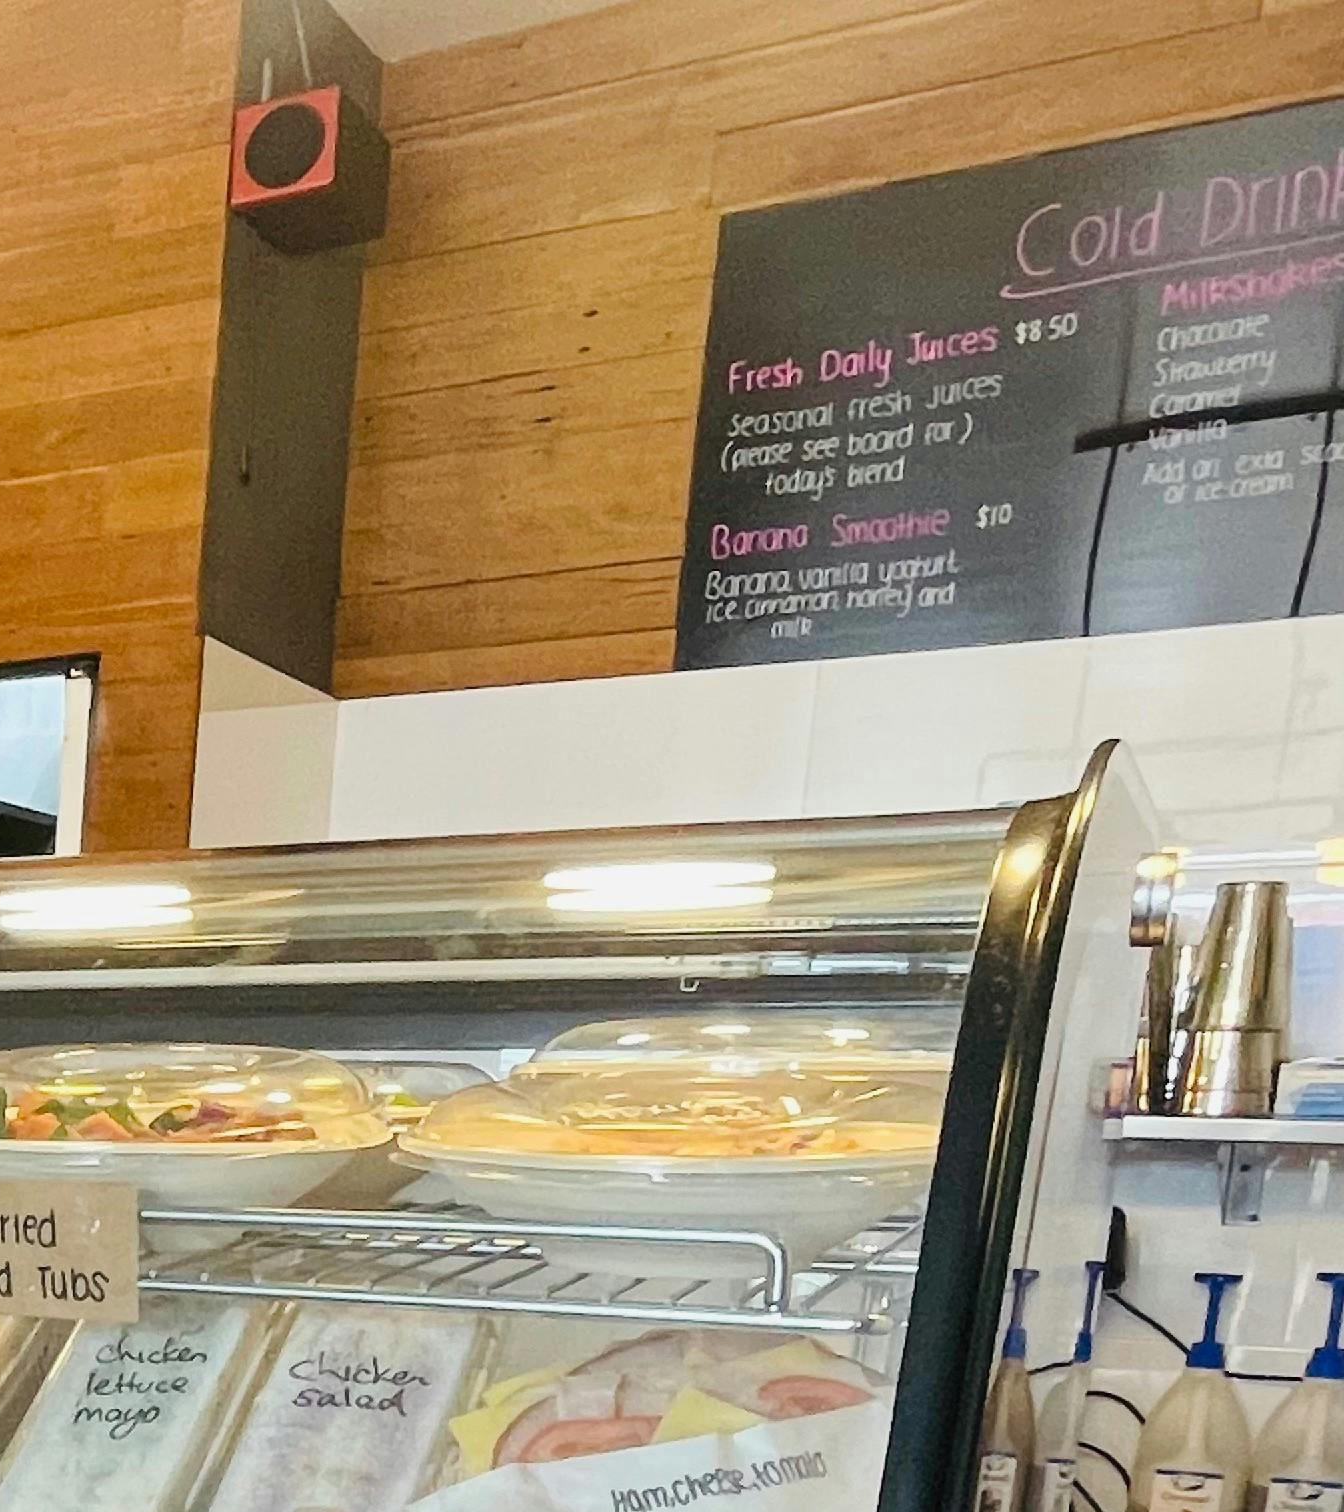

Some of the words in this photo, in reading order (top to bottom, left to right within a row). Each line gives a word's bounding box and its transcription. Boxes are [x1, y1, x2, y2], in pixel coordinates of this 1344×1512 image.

[1016, 191, 1163, 276] Cold
[728, 357, 804, 394] Fresh
[820, 339, 893, 388] Daily
[907, 326, 1000, 366] Juices
[848, 388, 912, 421] fresh
[925, 373, 1004, 409] juices
[802, 434, 840, 462] see
[848, 422, 914, 457] board
[847, 455, 906, 488] blend
[711, 523, 809, 560] Banana
[830, 508, 951, 548] Smoothie
[976, 502, 1012, 530] $10
[705, 569, 793, 600] Banana
[799, 561, 869, 591] vanilla
[706, 601, 737, 624] ice
[918, 581, 956, 608] and
[38, 1264, 111, 1303] Tubs
[86, 1371, 193, 1399] lettuce
[72, 1402, 160, 1440] mayo
